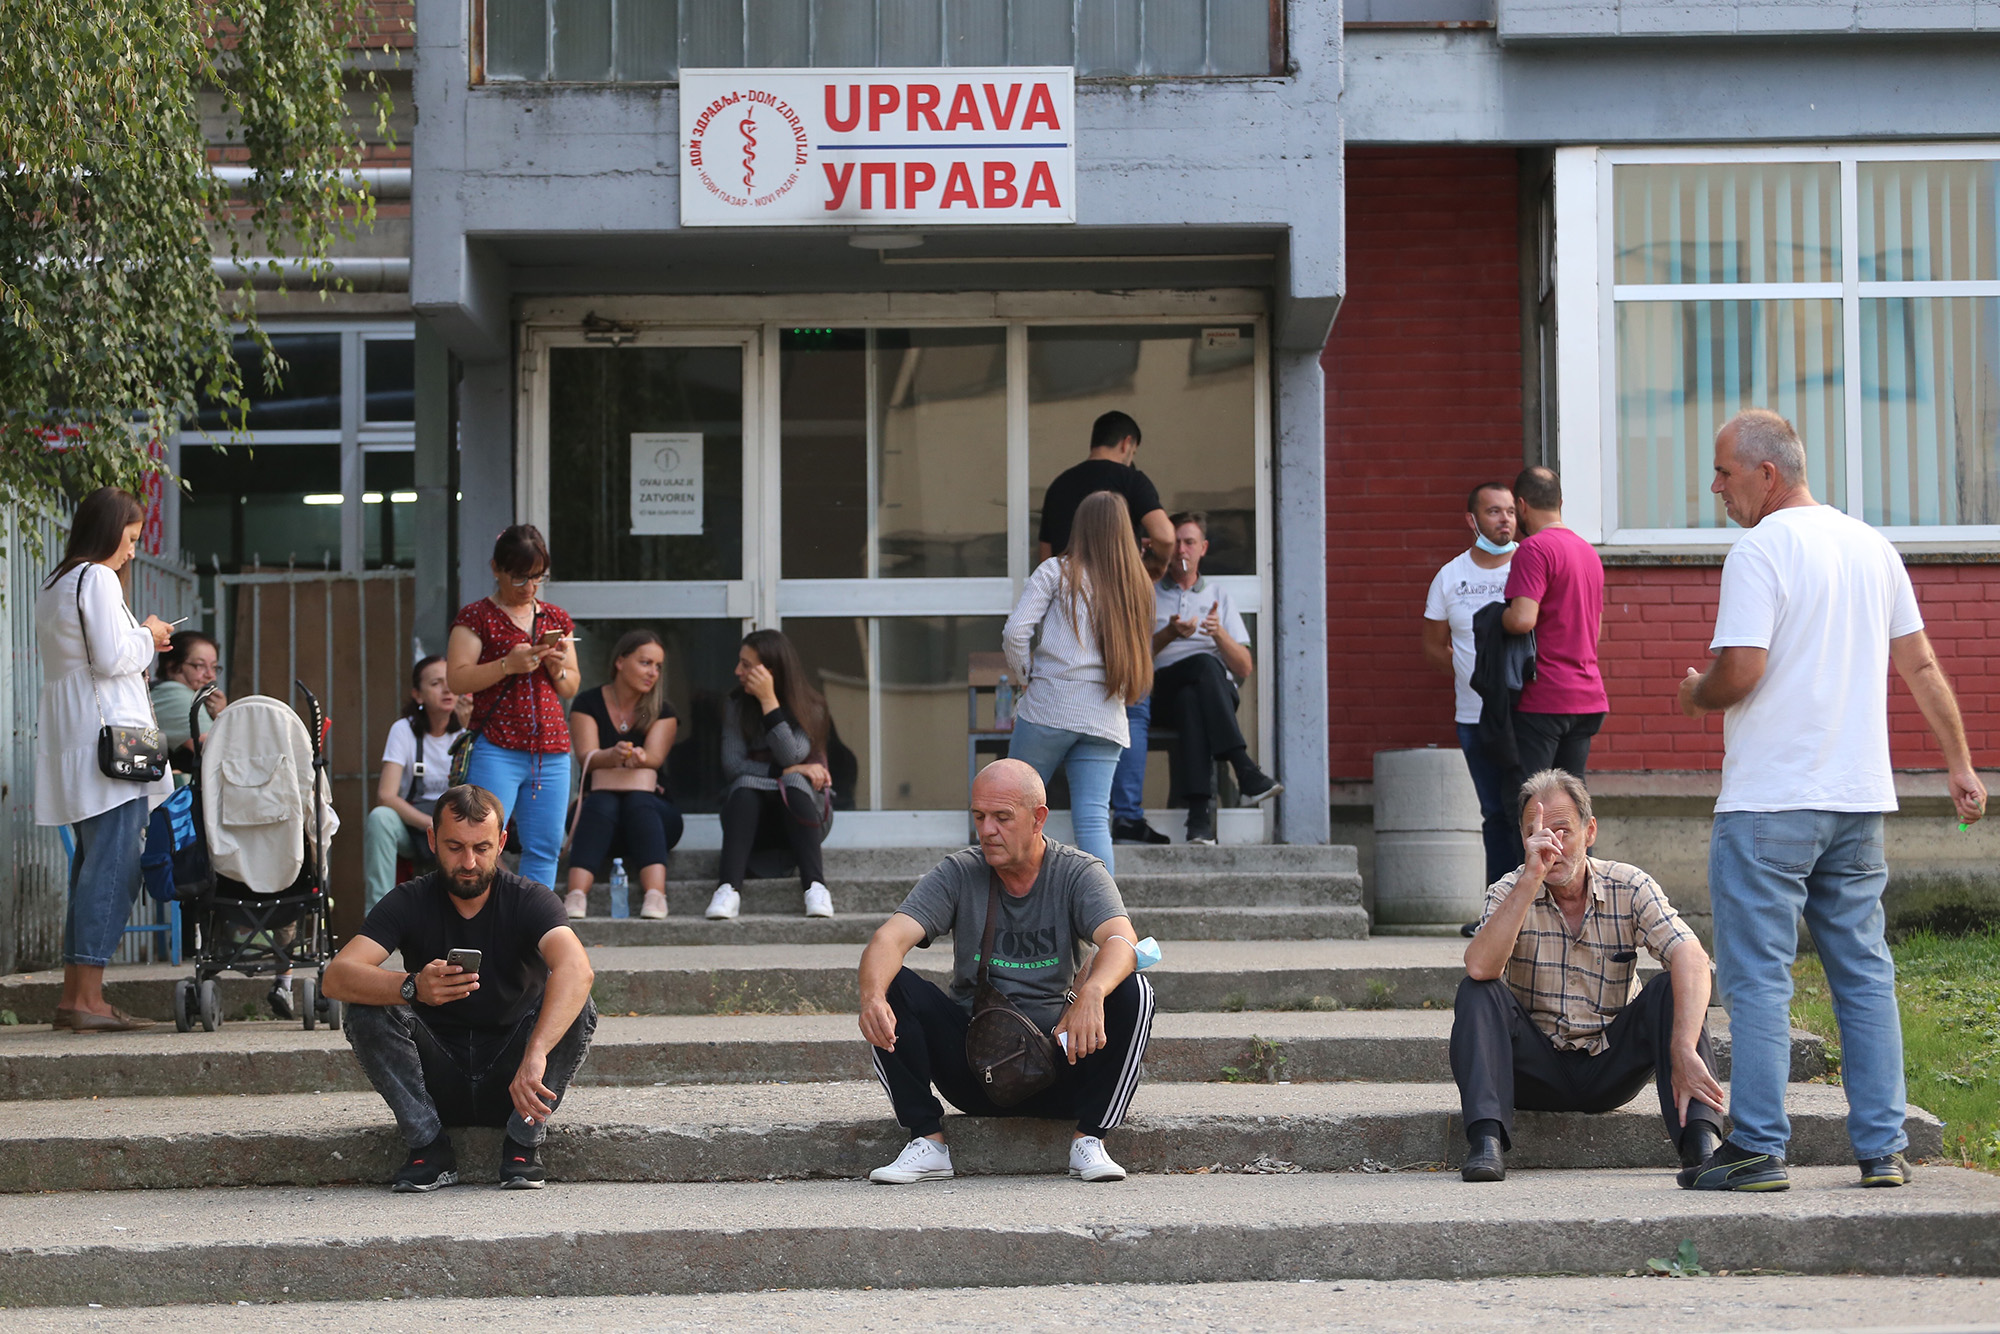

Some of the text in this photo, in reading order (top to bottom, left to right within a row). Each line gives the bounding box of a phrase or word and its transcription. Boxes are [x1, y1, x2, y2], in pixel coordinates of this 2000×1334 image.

[824, 83, 1061, 132] UPRAVA
[690, 140, 703, 166] ДОМ
[776, 101, 808, 165] ZDRAVLJA
[699, 171, 799, 207] НОВИ ПАЗАР NOVI PAZAR
[822, 161, 1061, 211] УПРАВА
[640, 493, 695, 502] ZATVOREN
[994, 927, 1057, 960] OSS
